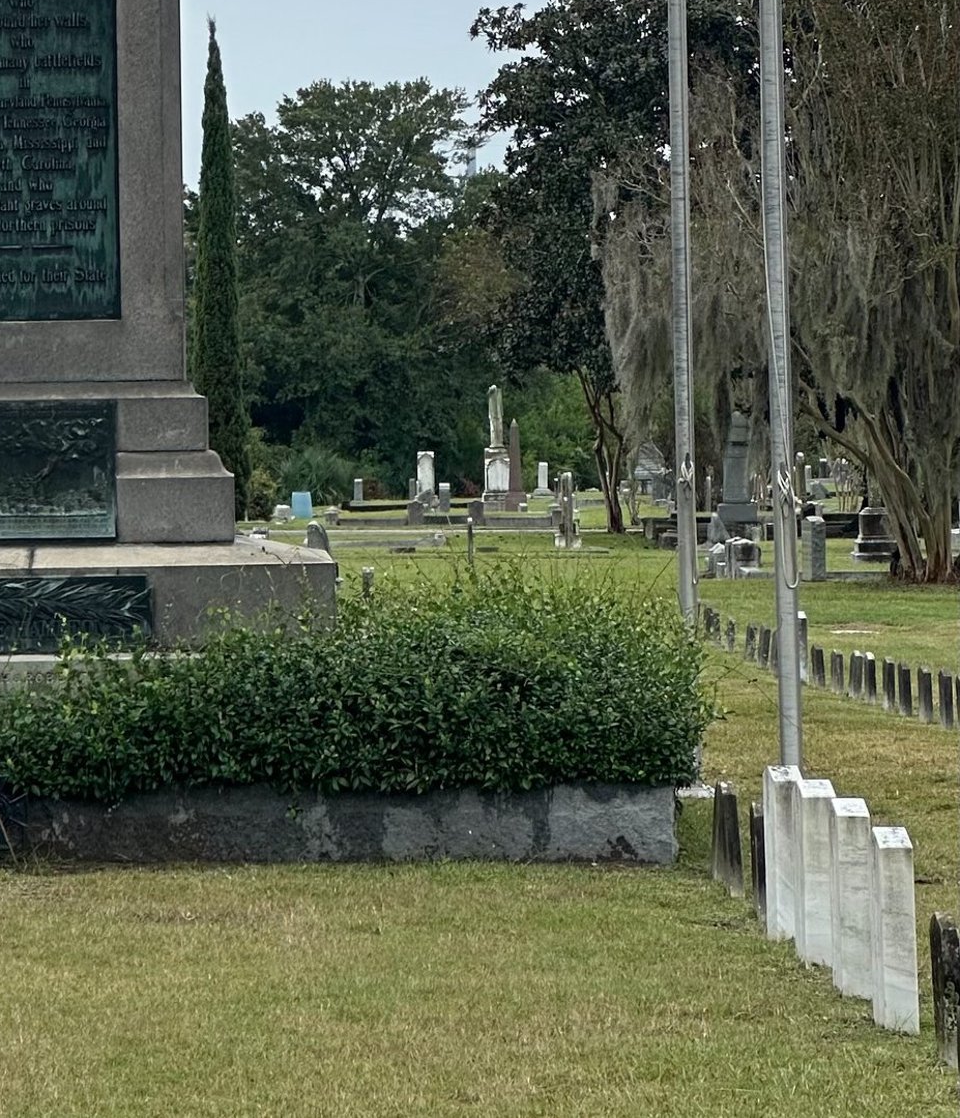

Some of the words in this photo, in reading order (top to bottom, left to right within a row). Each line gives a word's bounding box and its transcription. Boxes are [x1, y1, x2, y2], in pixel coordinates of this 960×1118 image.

[28, 13, 51, 29] her
[10, 34, 35, 49] who
[19, 75, 31, 89] in
[87, 137, 107, 148] and
[0, 178, 23, 192] and
[29, 177, 53, 192] who
[25, 200, 62, 216] graves
[67, 196, 107, 212] around
[20, 269, 36, 284] for
[42, 267, 68, 284] their
